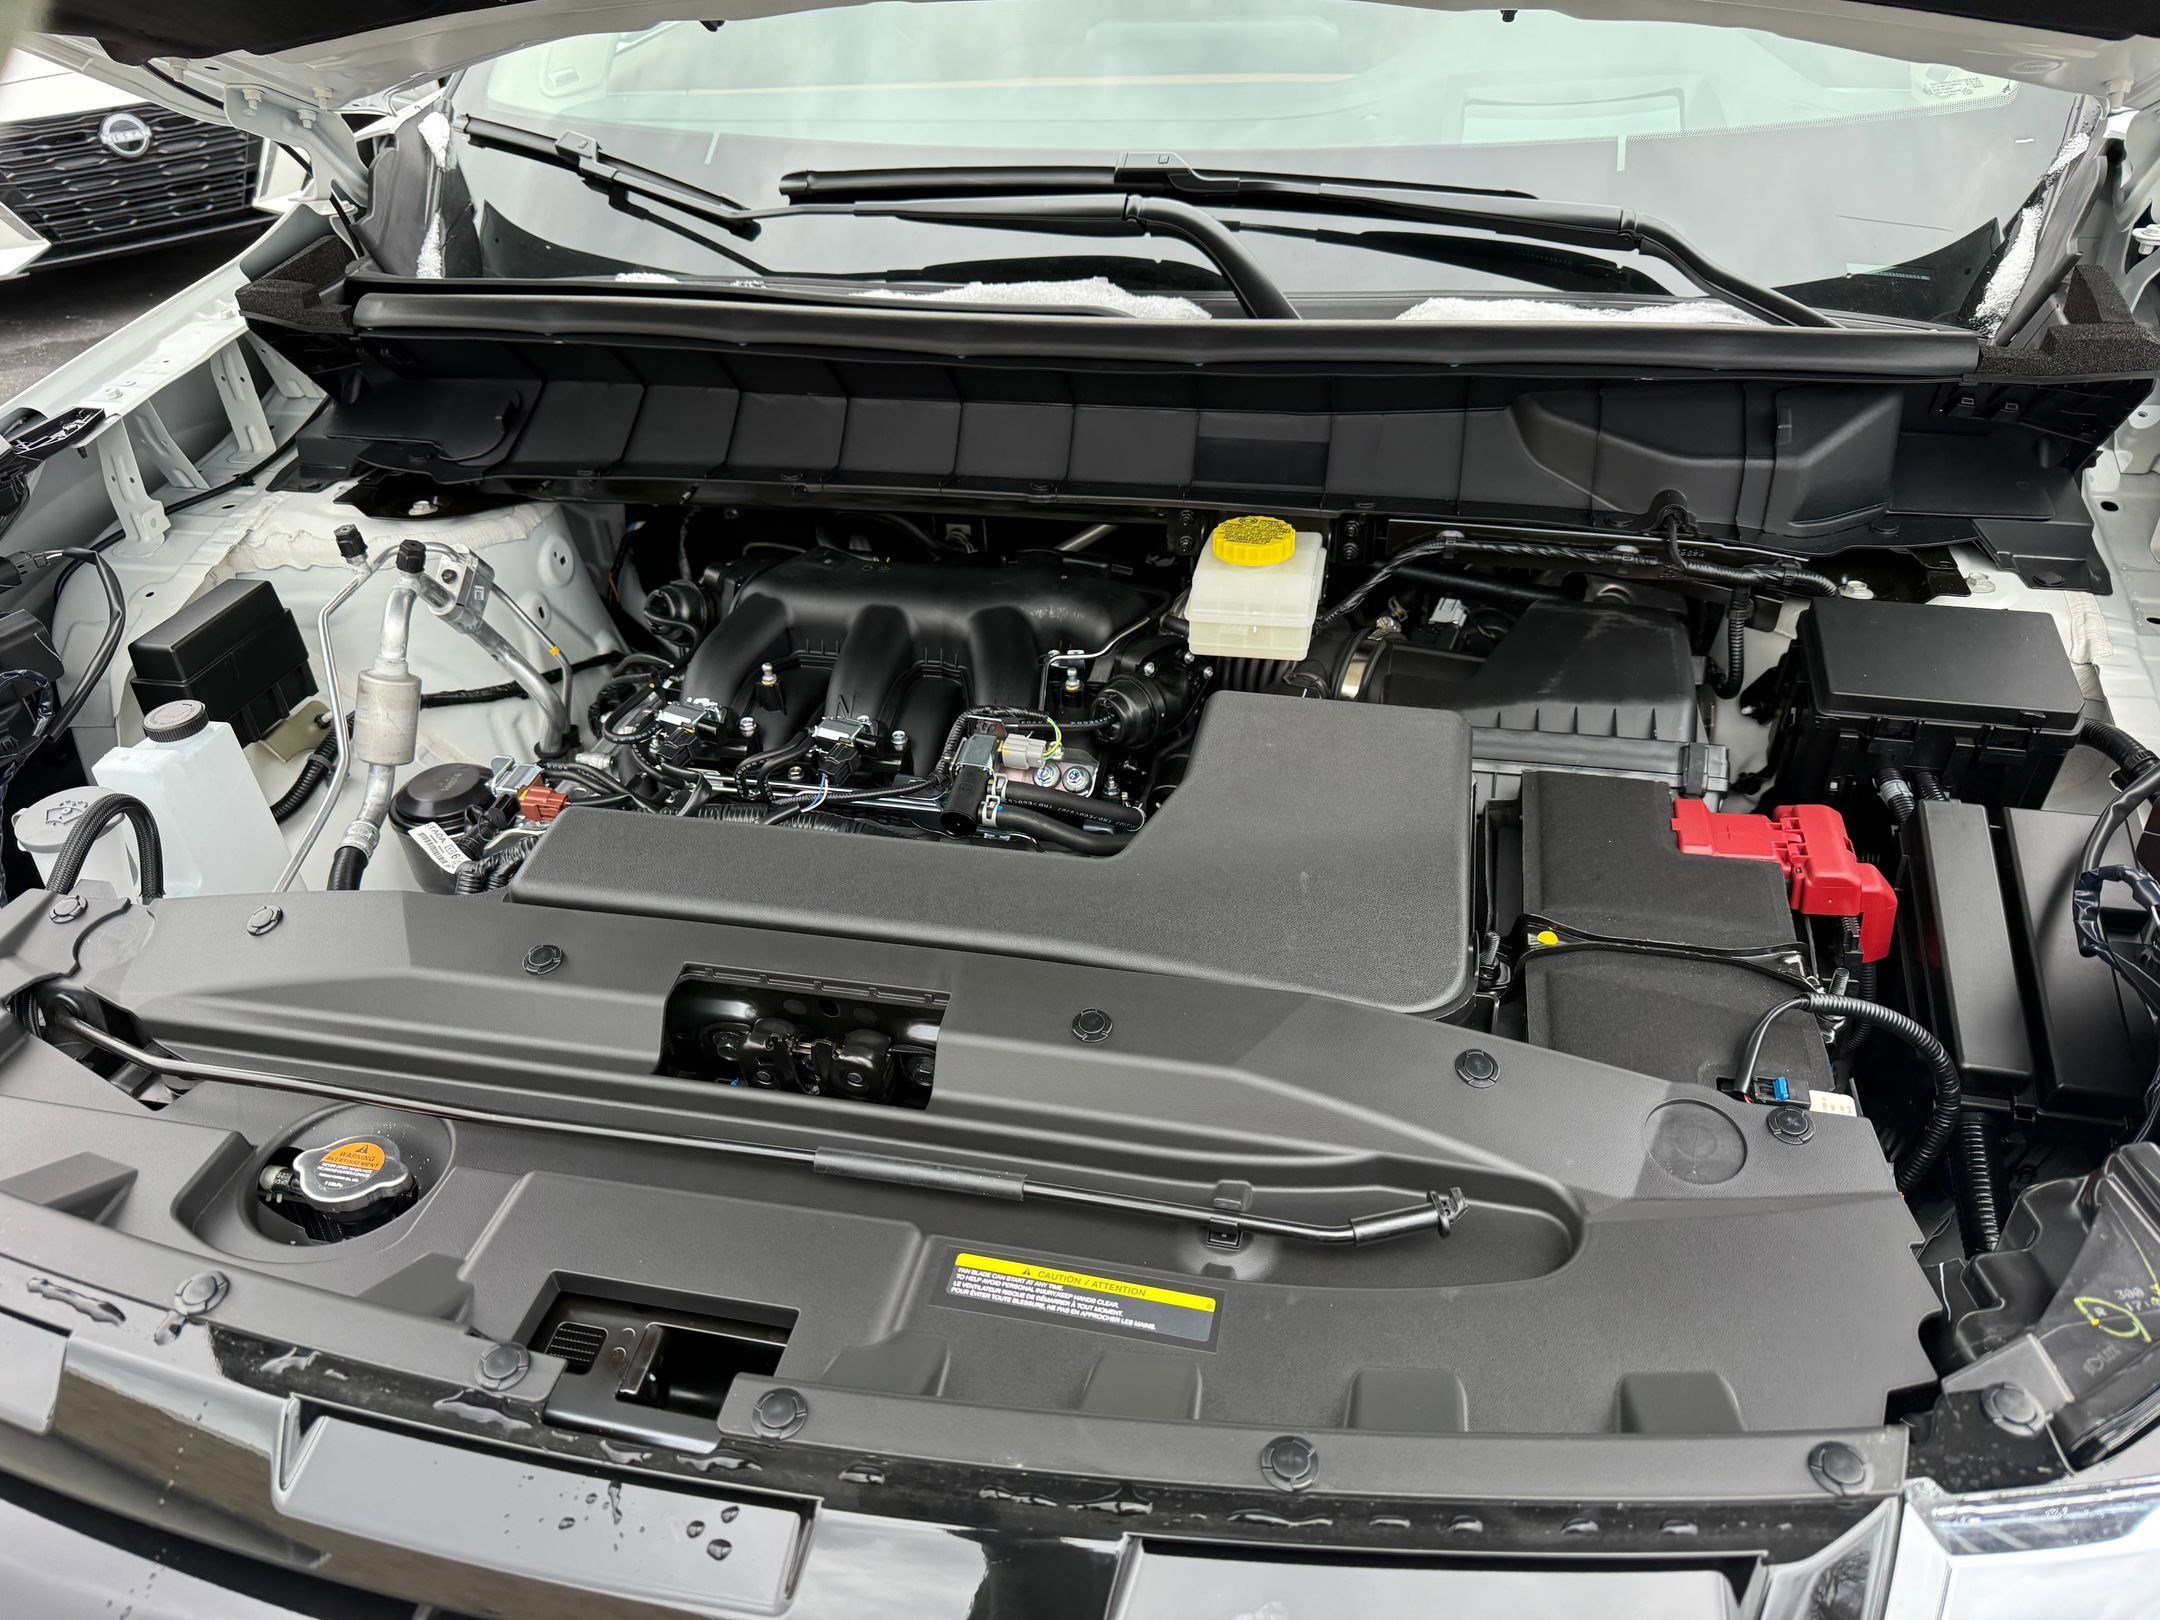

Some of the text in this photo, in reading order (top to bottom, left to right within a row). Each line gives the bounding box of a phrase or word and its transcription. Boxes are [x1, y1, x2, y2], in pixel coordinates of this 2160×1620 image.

[327, 1156, 378, 1168] AVERTISSEMENT
[340, 1151, 376, 1162] WARNING
[966, 1275, 982, 1283] HELP
[982, 1277, 1001, 1286] AVOID
[1002, 1281, 1035, 1292] PERSONAL
[1073, 1294, 1096, 1303] HANDS
[971, 1269, 991, 1277] BLADE
[1006, 1275, 1026, 1284] START
[1034, 1280, 1048, 1288] ANY
[1038, 1270, 1081, 1284] CAUTION
[1091, 1280, 1146, 1296] ATTENTION
[951, 1286, 969, 1295] POUR
[992, 1294, 1011, 1302] TOUTE
[1057, 1305, 1070, 1313] PAS
[1079, 1310, 1120, 1323] APPROCHER
[962, 1281, 1001, 1294] VENTILATEUR
[1076, 1302, 1094, 1311] TOUT
